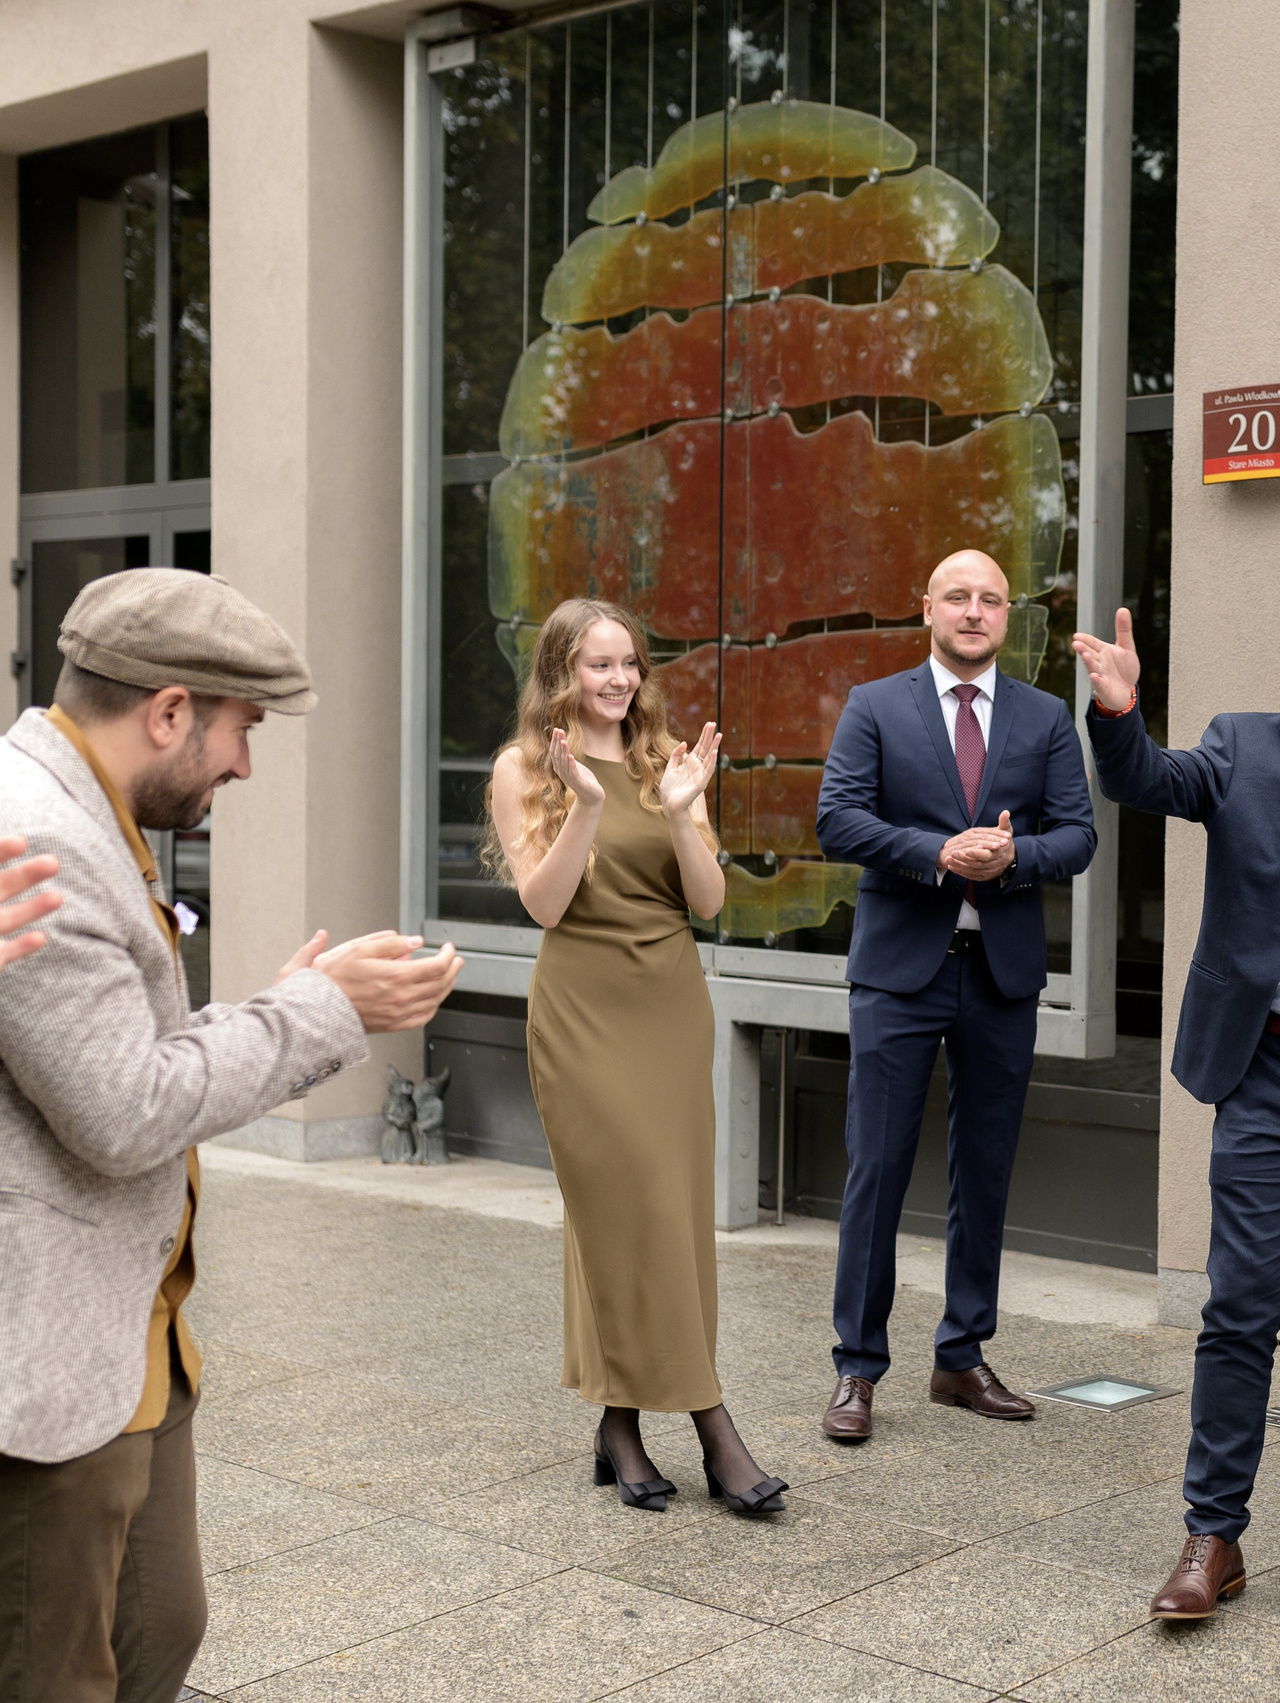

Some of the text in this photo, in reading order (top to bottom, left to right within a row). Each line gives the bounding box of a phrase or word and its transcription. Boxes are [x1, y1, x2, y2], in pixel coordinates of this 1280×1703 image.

[1227, 410, 1276, 454] 20
[1228, 458, 1275, 470] Stare Miasto
